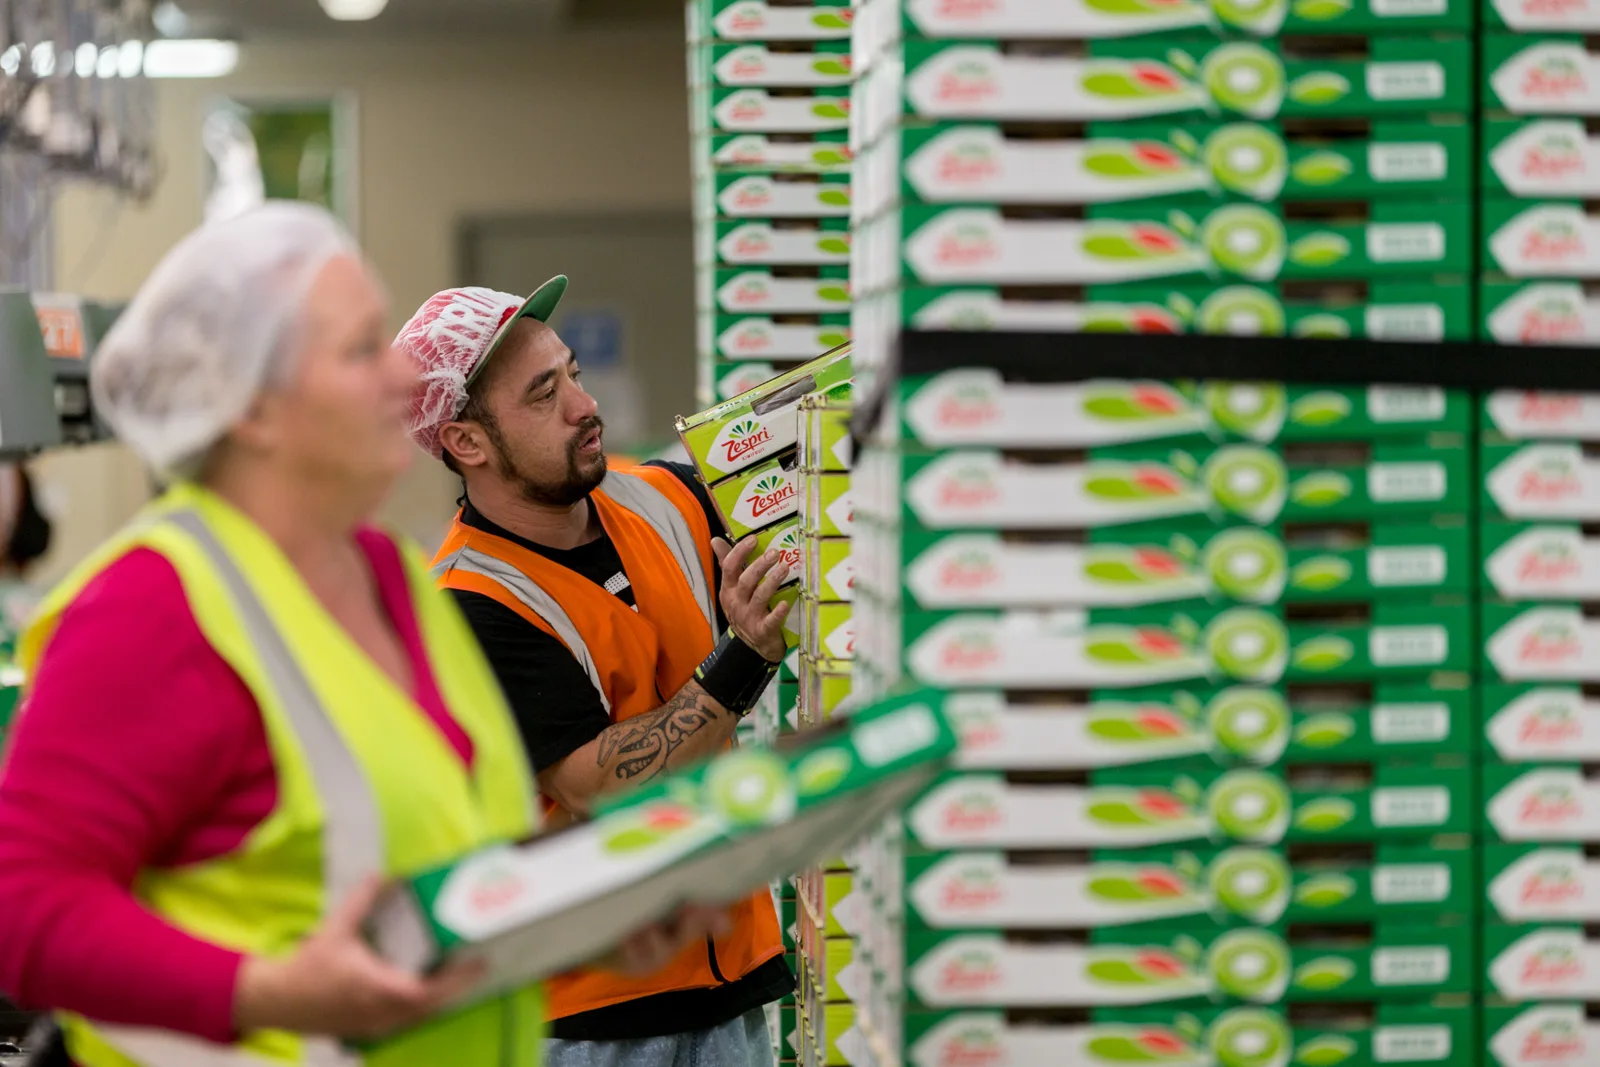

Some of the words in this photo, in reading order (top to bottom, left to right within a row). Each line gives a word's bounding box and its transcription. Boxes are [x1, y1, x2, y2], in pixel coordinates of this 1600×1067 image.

[721, 427, 772, 462] Zespri
[746, 482, 797, 518] Zespri
[779, 548, 800, 567] Zes
